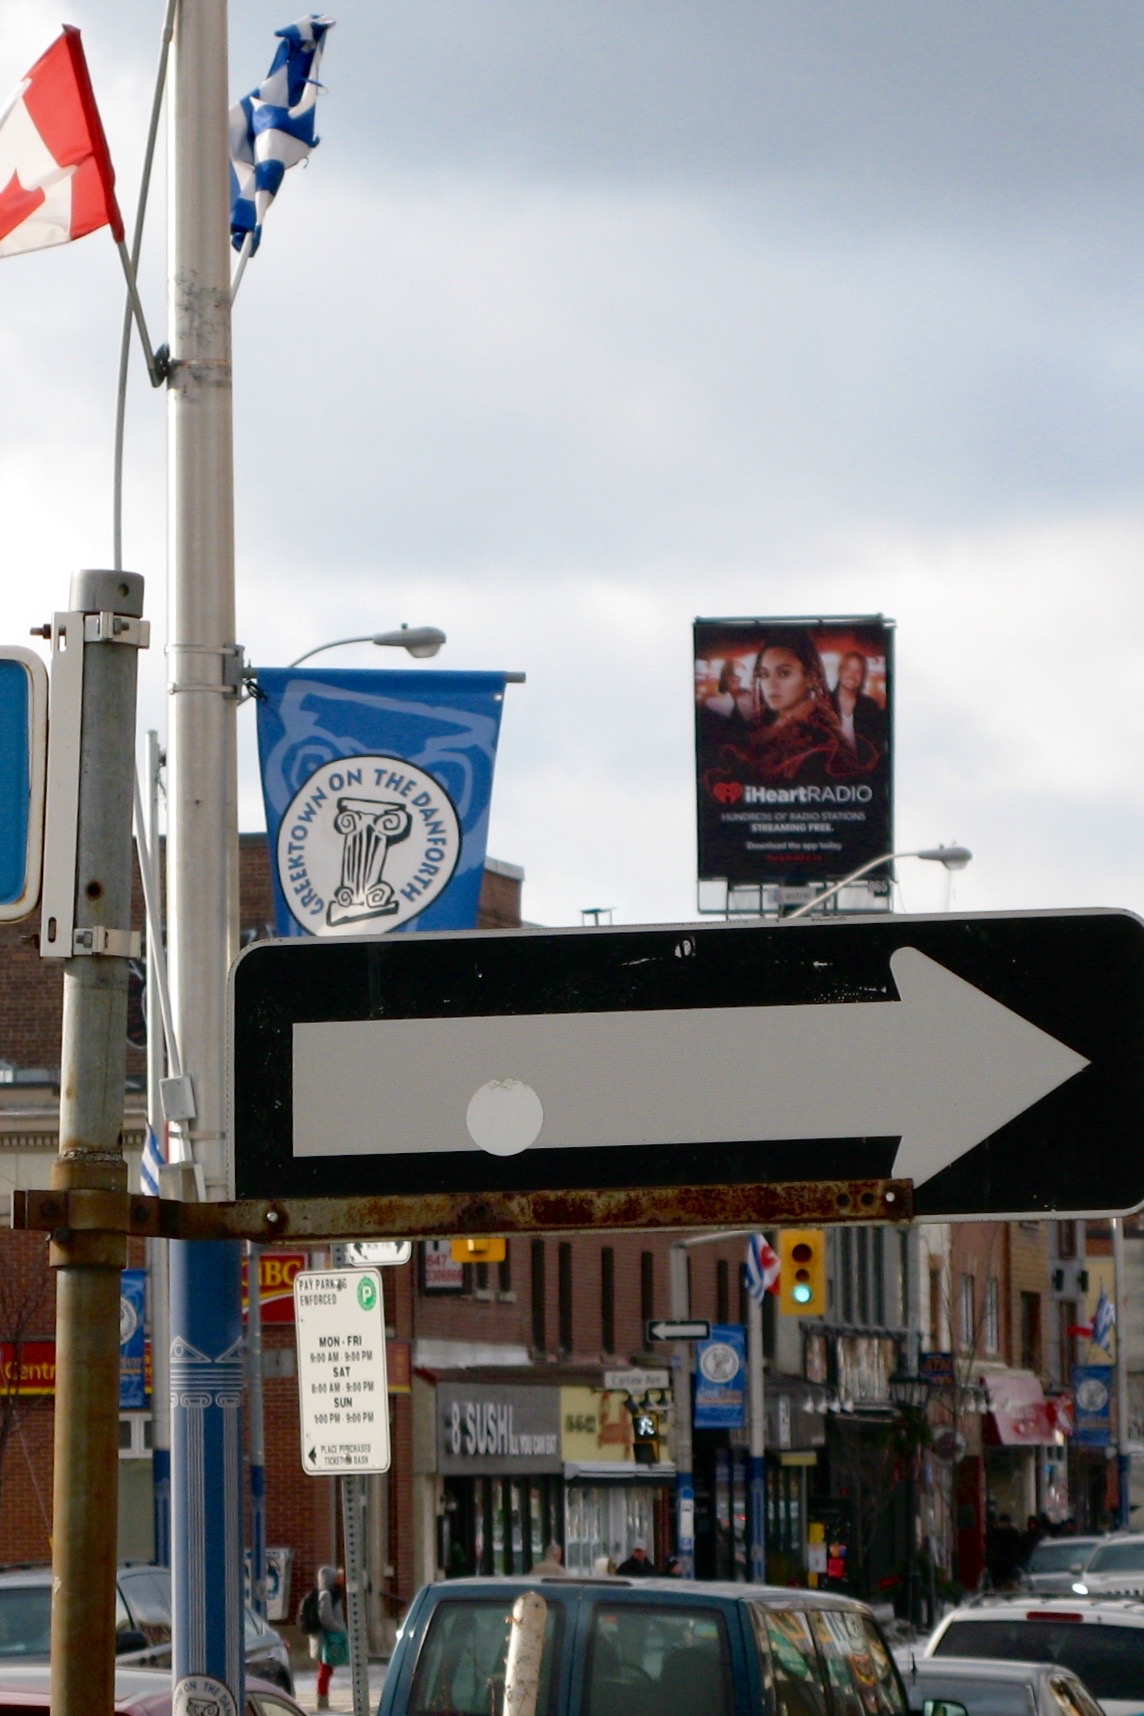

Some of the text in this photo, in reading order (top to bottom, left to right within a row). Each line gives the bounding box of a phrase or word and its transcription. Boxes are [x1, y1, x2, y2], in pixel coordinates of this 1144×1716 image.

[744, 784, 874, 803] iHeartRADIO
[721, 811, 867, 822] HUNDREDS OF RADIO STATIONS
[751, 822, 806, 833] STREAMING
[287, 768, 448, 916] GREEKTOWN ON THE DANFORTH
[746, 841, 787, 850] Download
[788, 841, 801, 850] the
[802, 843, 817, 852] app
[299, 1279, 314, 1291] PAY
[300, 1293, 338, 1307] ENFORCED
[319, 1336, 341, 1348] MON
[347, 1335, 363, 1347] FRI
[309, 1352, 327, 1364] 9:00
[328, 1351, 340, 1363] AM
[344, 1351, 361, 1363] 9:00
[362, 1350, 374, 1362] PM
[6, 1362, 56, 1380] Centr
[332, 1366, 352, 1378] SAT
[311, 1382, 328, 1394] 8:00
[329, 1381, 341, 1393] AM
[345, 1381, 362, 1393] 9:00
[363, 1380, 375, 1392] PM
[333, 1397, 353, 1408] SUN
[313, 1413, 328, 1425] 1:00
[329, 1412, 341, 1424] PM
[345, 1412, 362, 1424] 9:00
[363, 1411, 375, 1423] PM
[465, 1401, 513, 1456] SUSHI
[321, 1443, 372, 1454] PLACE PURCHASED
[324, 1456, 344, 1466] TICKET
[353, 1455, 369, 1465] DASH
